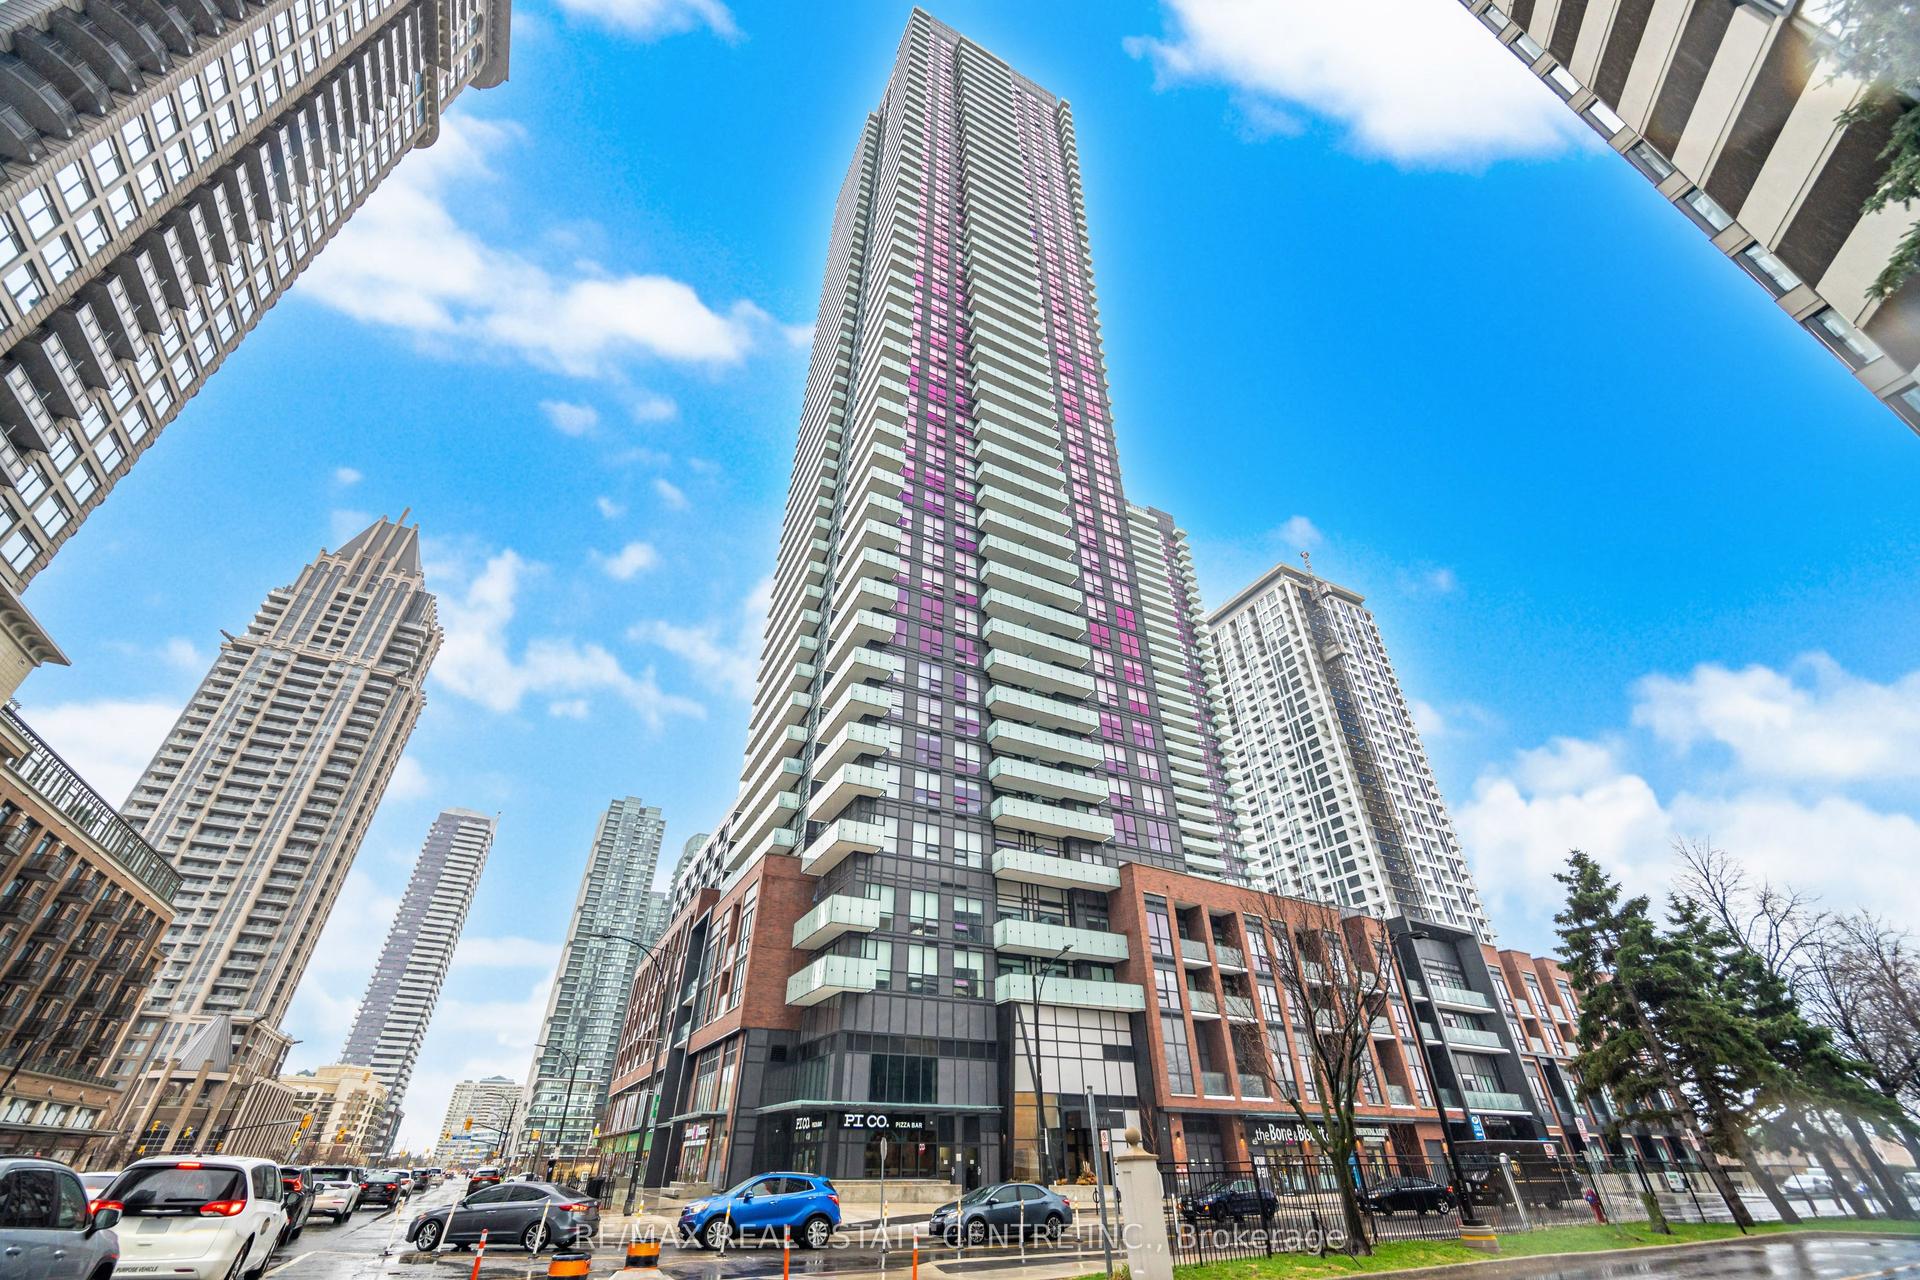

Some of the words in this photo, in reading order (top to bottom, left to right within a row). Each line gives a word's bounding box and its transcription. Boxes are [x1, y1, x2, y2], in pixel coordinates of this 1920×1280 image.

[843, 1114, 864, 1127] PI
[866, 1115, 889, 1128] CO.
[895, 1121, 911, 1129] PIZZA
[1255, 1127, 1270, 1141] the
[1268, 1123, 1293, 1141] Bone
[1296, 1124, 1329, 1144] Biscit
